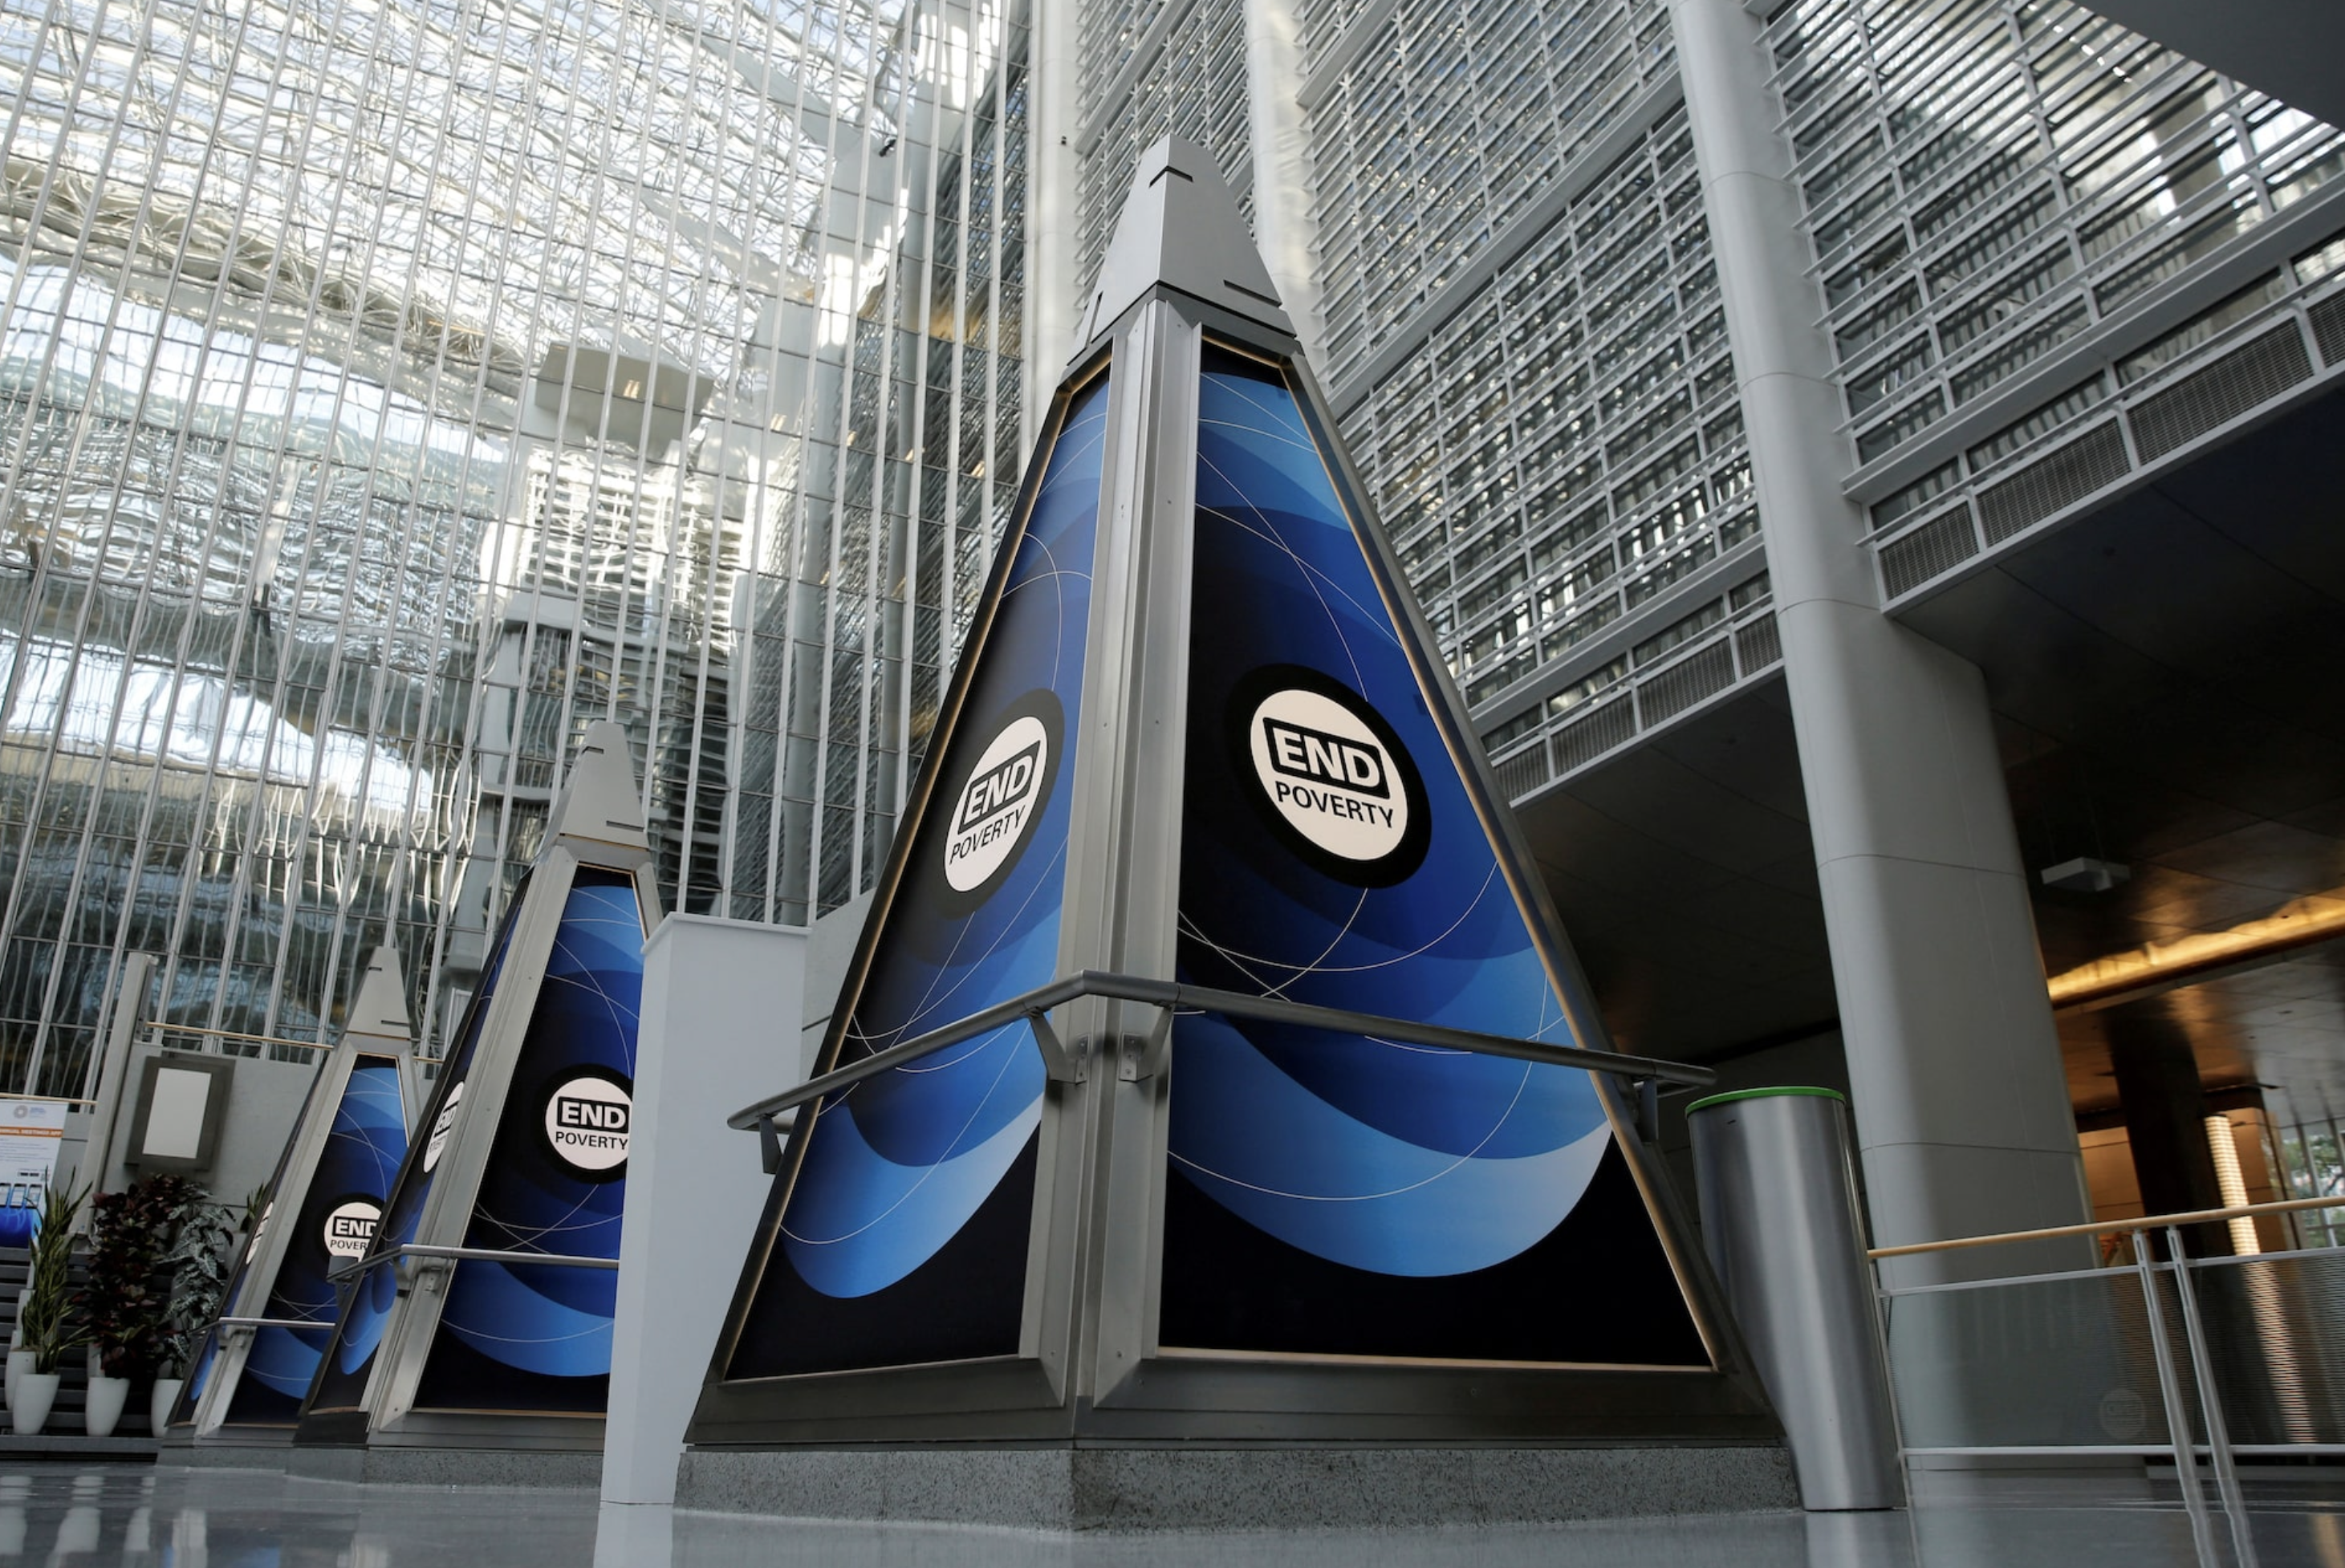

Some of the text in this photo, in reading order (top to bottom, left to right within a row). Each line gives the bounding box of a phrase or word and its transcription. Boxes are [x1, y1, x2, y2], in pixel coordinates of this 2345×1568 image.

[1272, 727, 1380, 788] END
[964, 754, 1033, 825] END
[1275, 780, 1393, 829] POVERTY
[949, 804, 1026, 866] POVERTY
[561, 1100, 626, 1129] END
[555, 1131, 628, 1151] POVERTY
[330, 1240, 368, 1250] POVER
